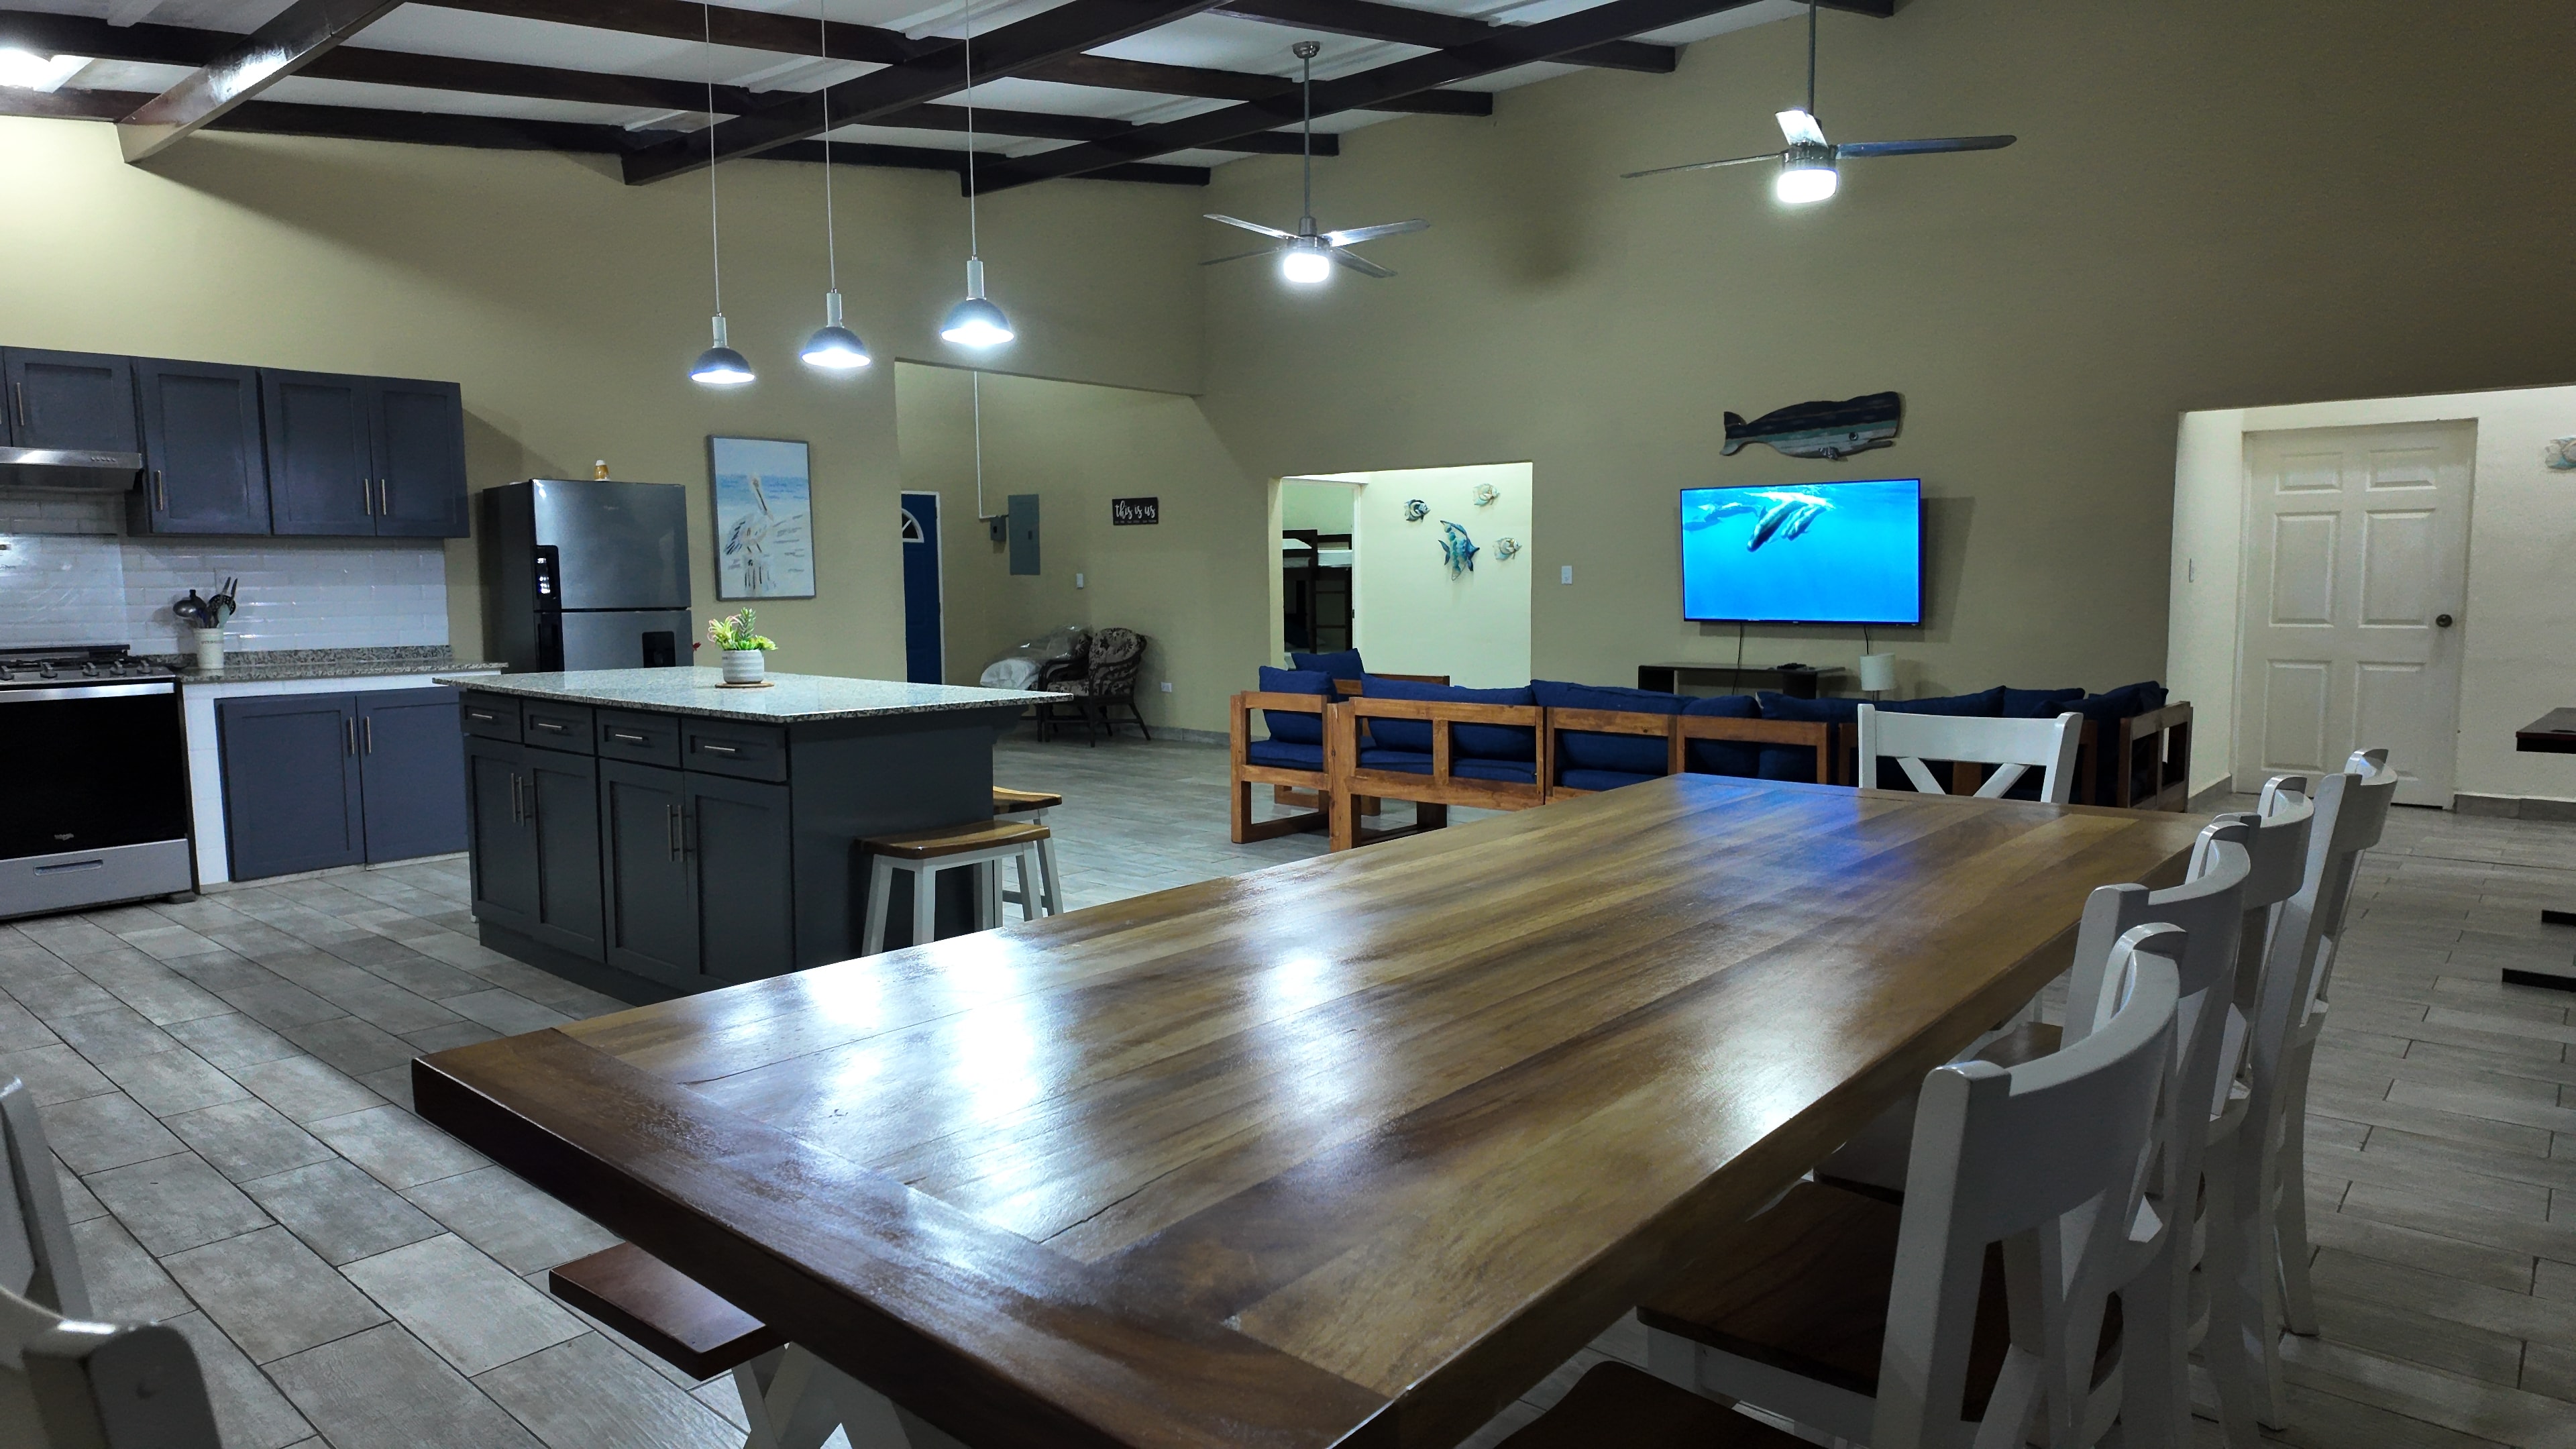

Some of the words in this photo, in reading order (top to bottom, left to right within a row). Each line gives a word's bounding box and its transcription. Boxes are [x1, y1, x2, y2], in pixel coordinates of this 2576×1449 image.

[1115, 500, 1132, 519] this
[1134, 504, 1142, 519] is
[1144, 504, 1155, 519] us
